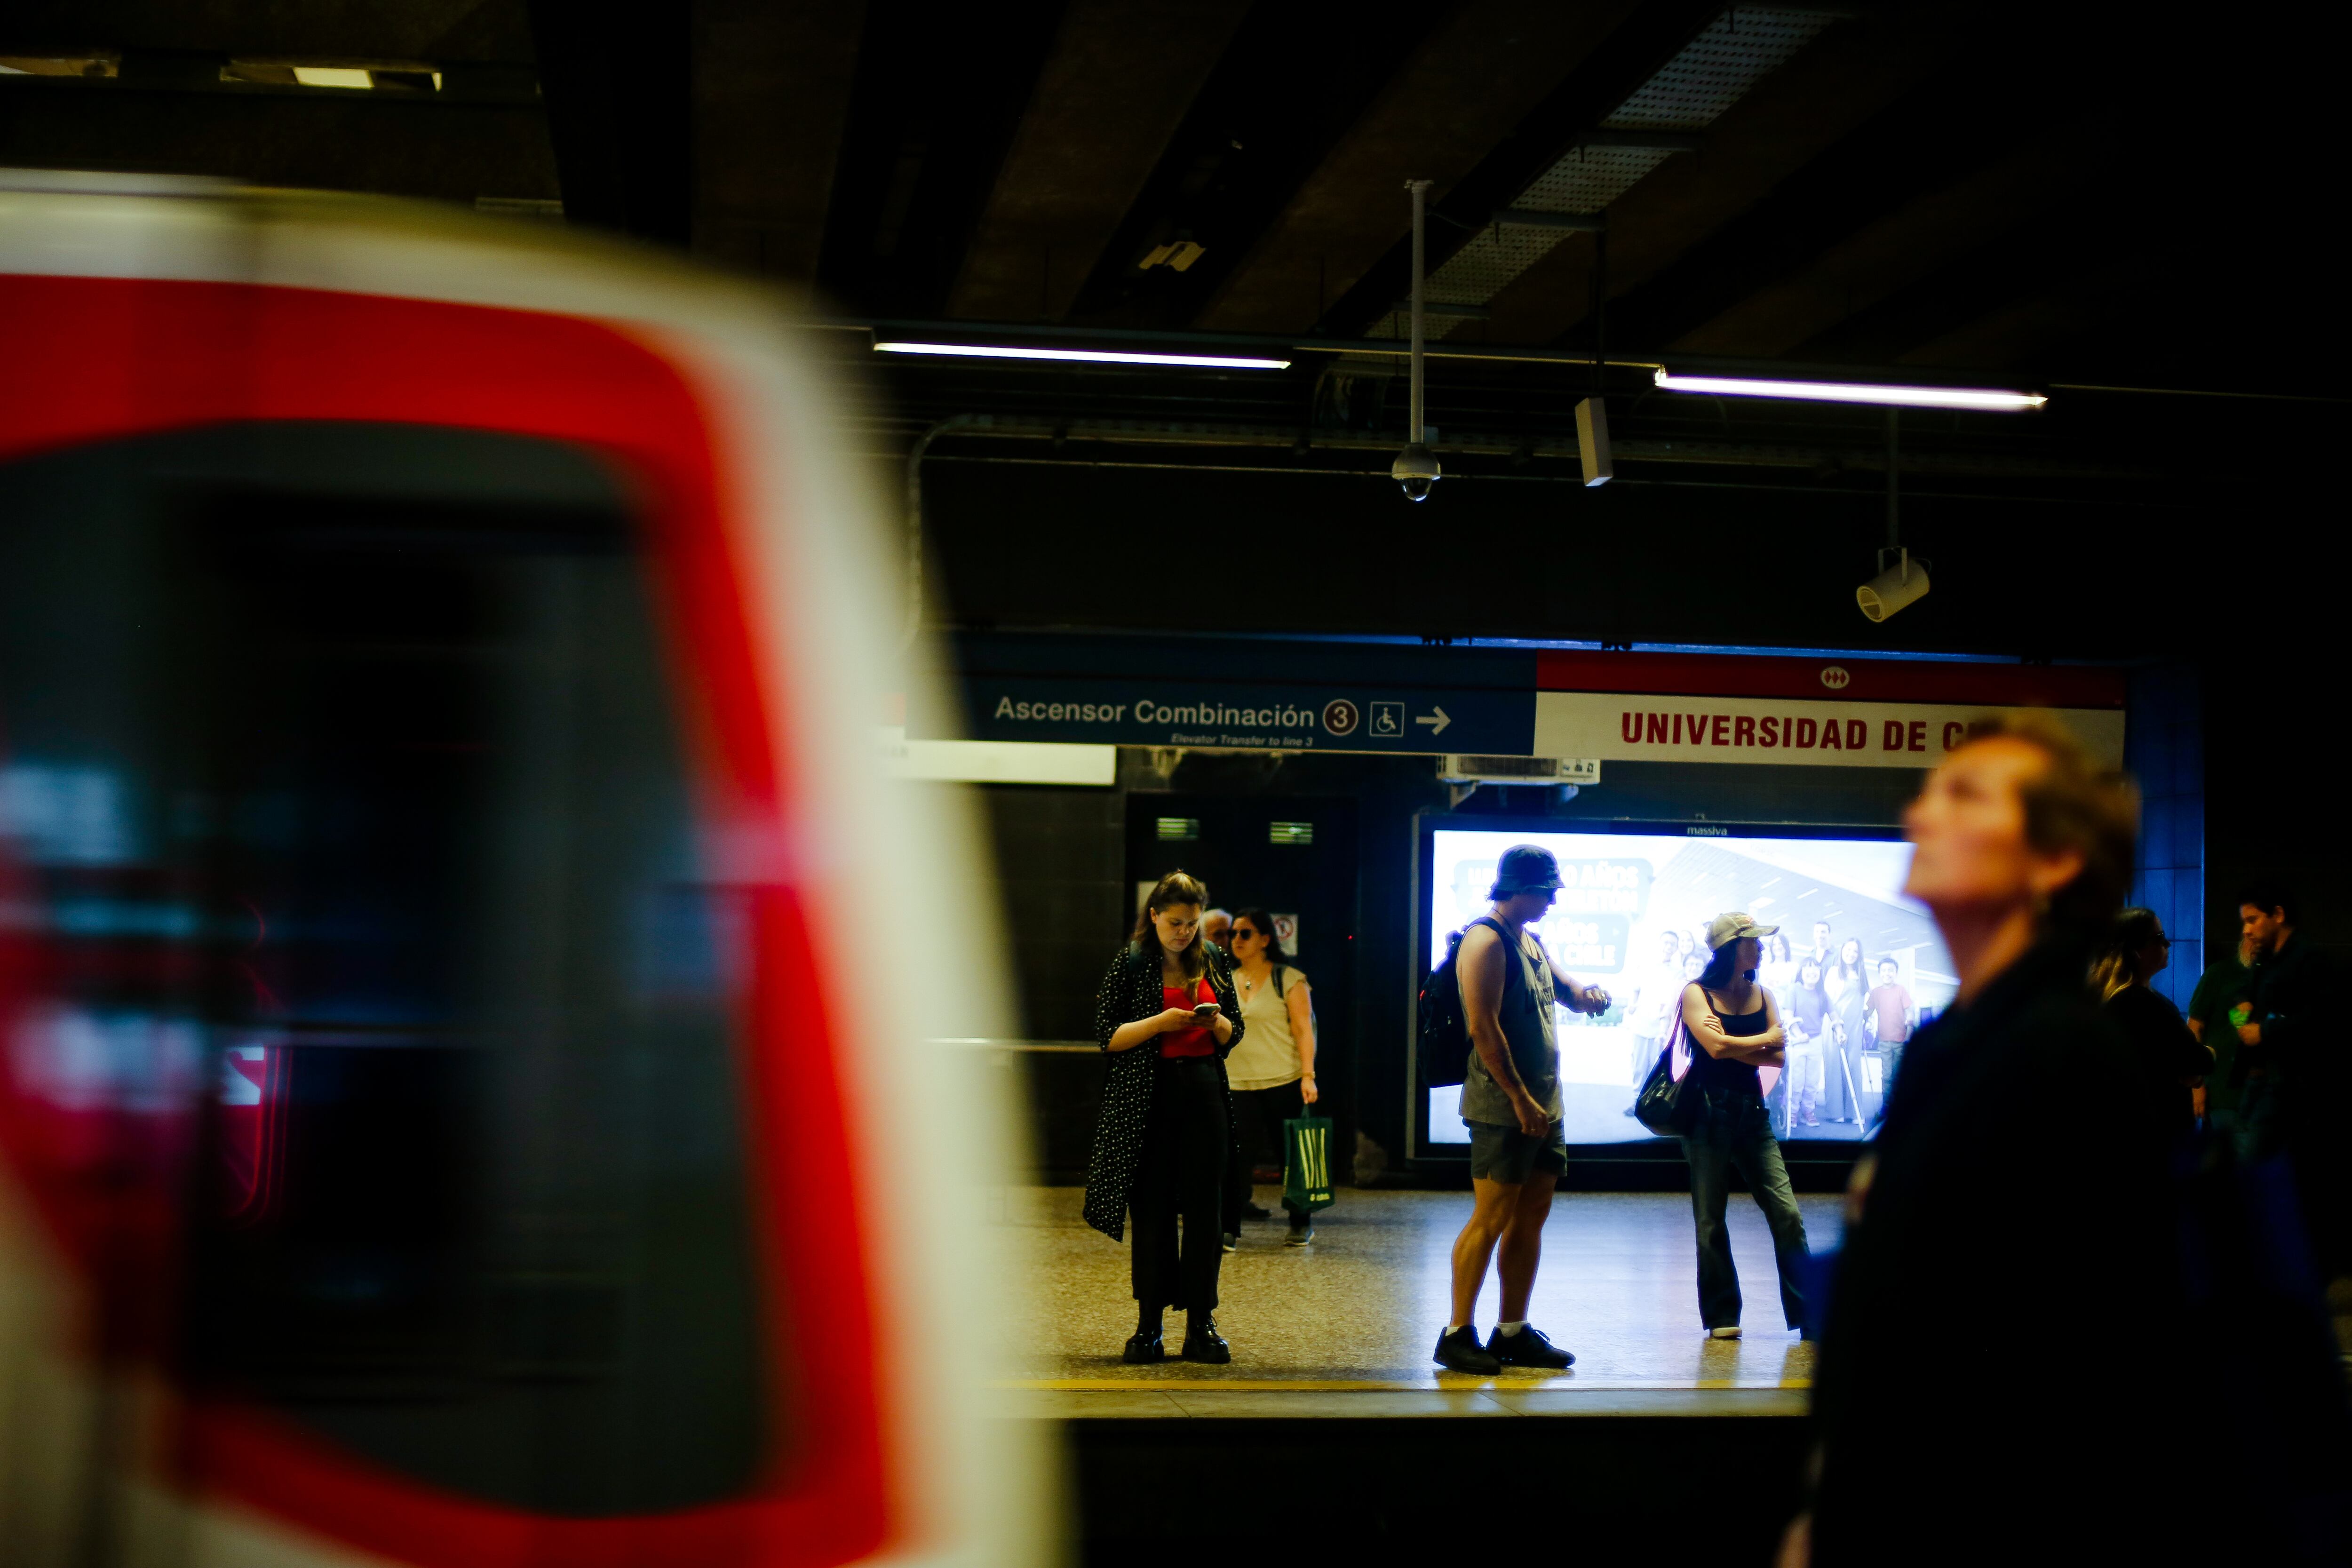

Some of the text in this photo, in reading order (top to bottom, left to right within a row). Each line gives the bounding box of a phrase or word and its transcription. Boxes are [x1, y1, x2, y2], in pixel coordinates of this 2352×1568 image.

[994, 696, 1348, 728] Ascensor Combinación 3
[1171, 732, 1313, 747] Elevator Transfer to line 3
[1622, 712, 1867, 750] UNIVERSIDAD
[1883, 720, 1926, 752] DE
[1687, 825, 1727, 836] massiva
[1579, 860, 1639, 889] AÑOS
[1564, 944, 1616, 966] CHILE
